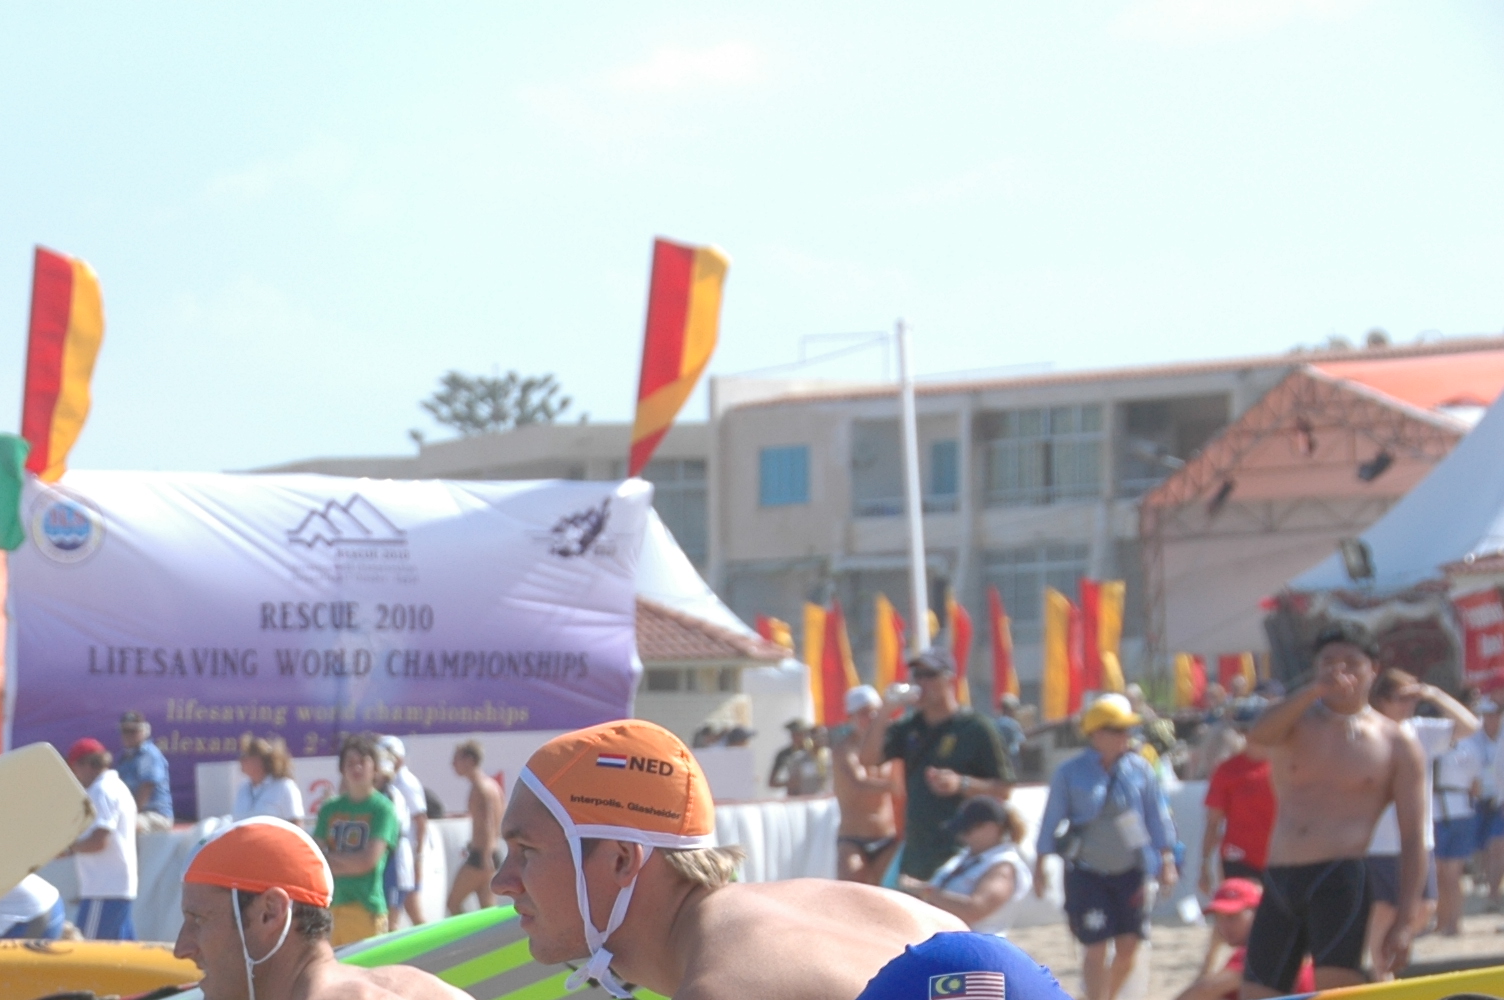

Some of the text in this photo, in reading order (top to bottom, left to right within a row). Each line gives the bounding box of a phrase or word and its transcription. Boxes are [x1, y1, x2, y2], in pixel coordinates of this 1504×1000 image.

[259, 600, 435, 632] RESCUE 2010
[87, 645, 590, 680] LIFESAVING WORLD CHAMPIONSHIPS
[166, 699, 289, 728] lifesaving
[363, 700, 531, 729] championships
[629, 755, 674, 777] NED
